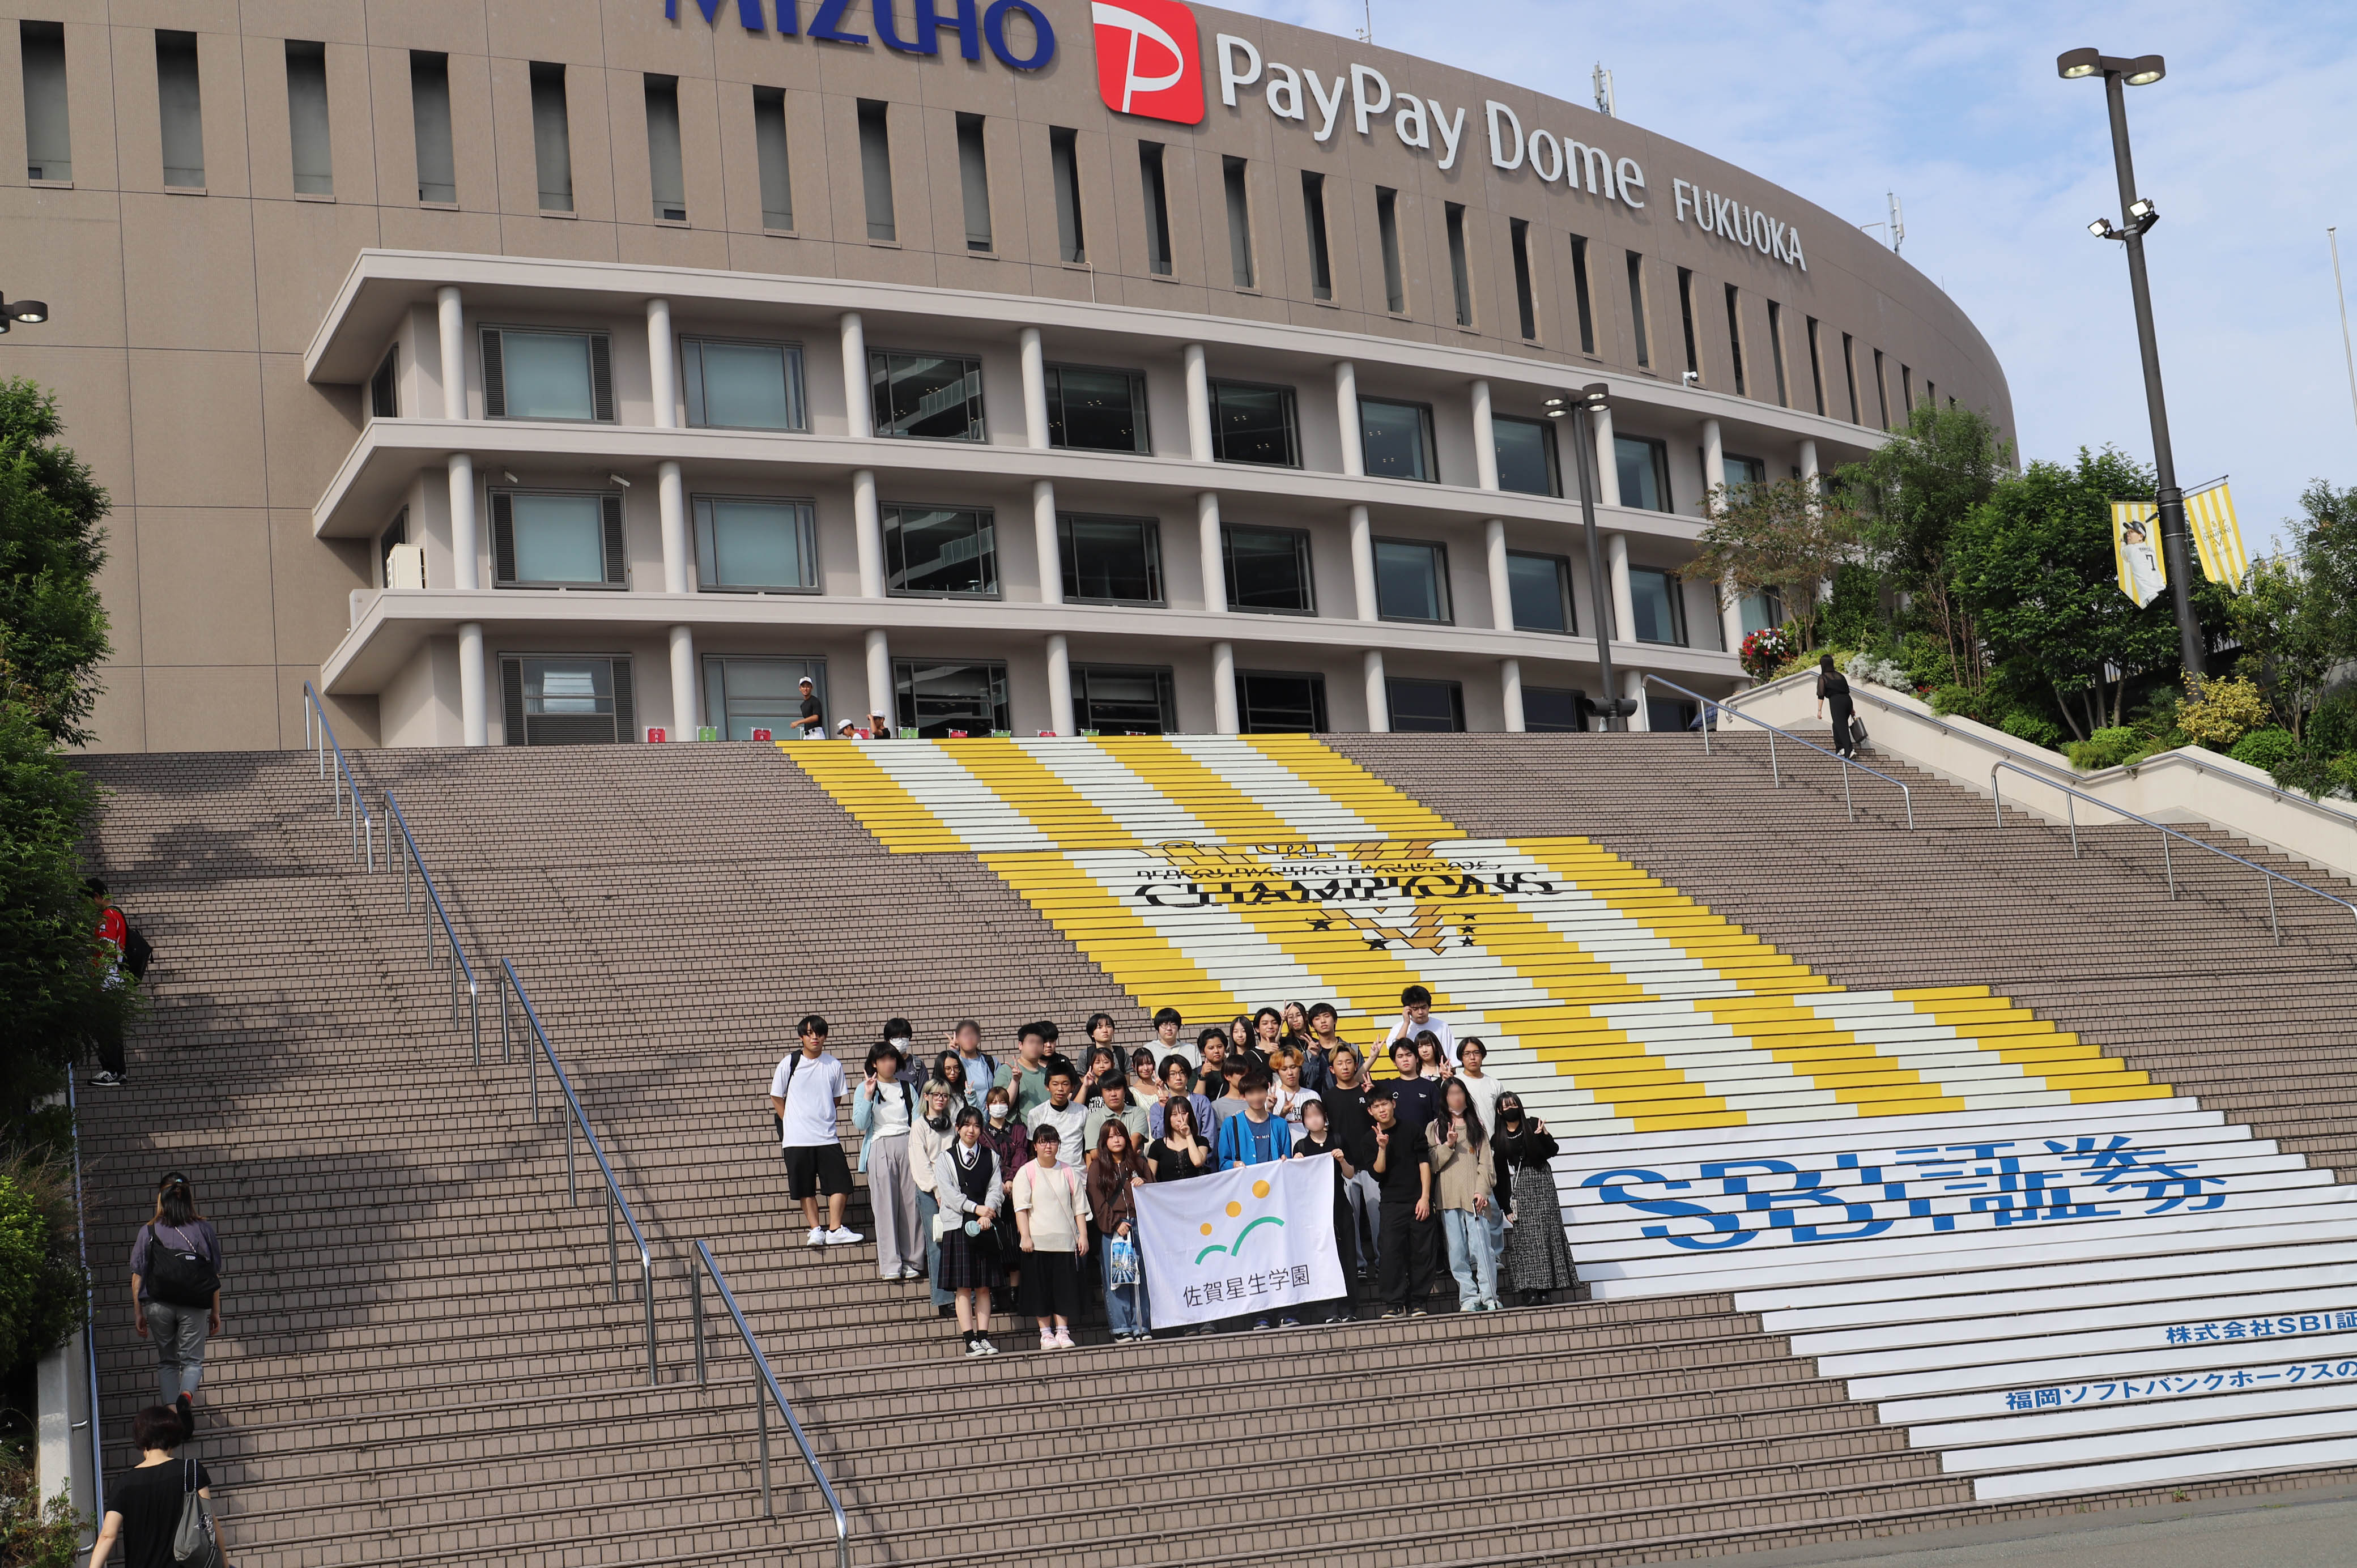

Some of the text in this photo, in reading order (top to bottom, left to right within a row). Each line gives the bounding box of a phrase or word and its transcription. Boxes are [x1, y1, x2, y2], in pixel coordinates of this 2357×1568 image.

[1216, 33, 1465, 170] PayPay
[1486, 100, 1645, 208] Dome
[1673, 177, 1807, 272] FUKUOKA
[2146, 554, 2156, 572] 7
[1335, 863, 1440, 874] LEAGUE
[1135, 872, 1564, 908] CHAMPIONS
[1581, 1136, 2226, 1250] SBI証券
[1183, 1264, 1310, 1308] 佐賀星生学園
